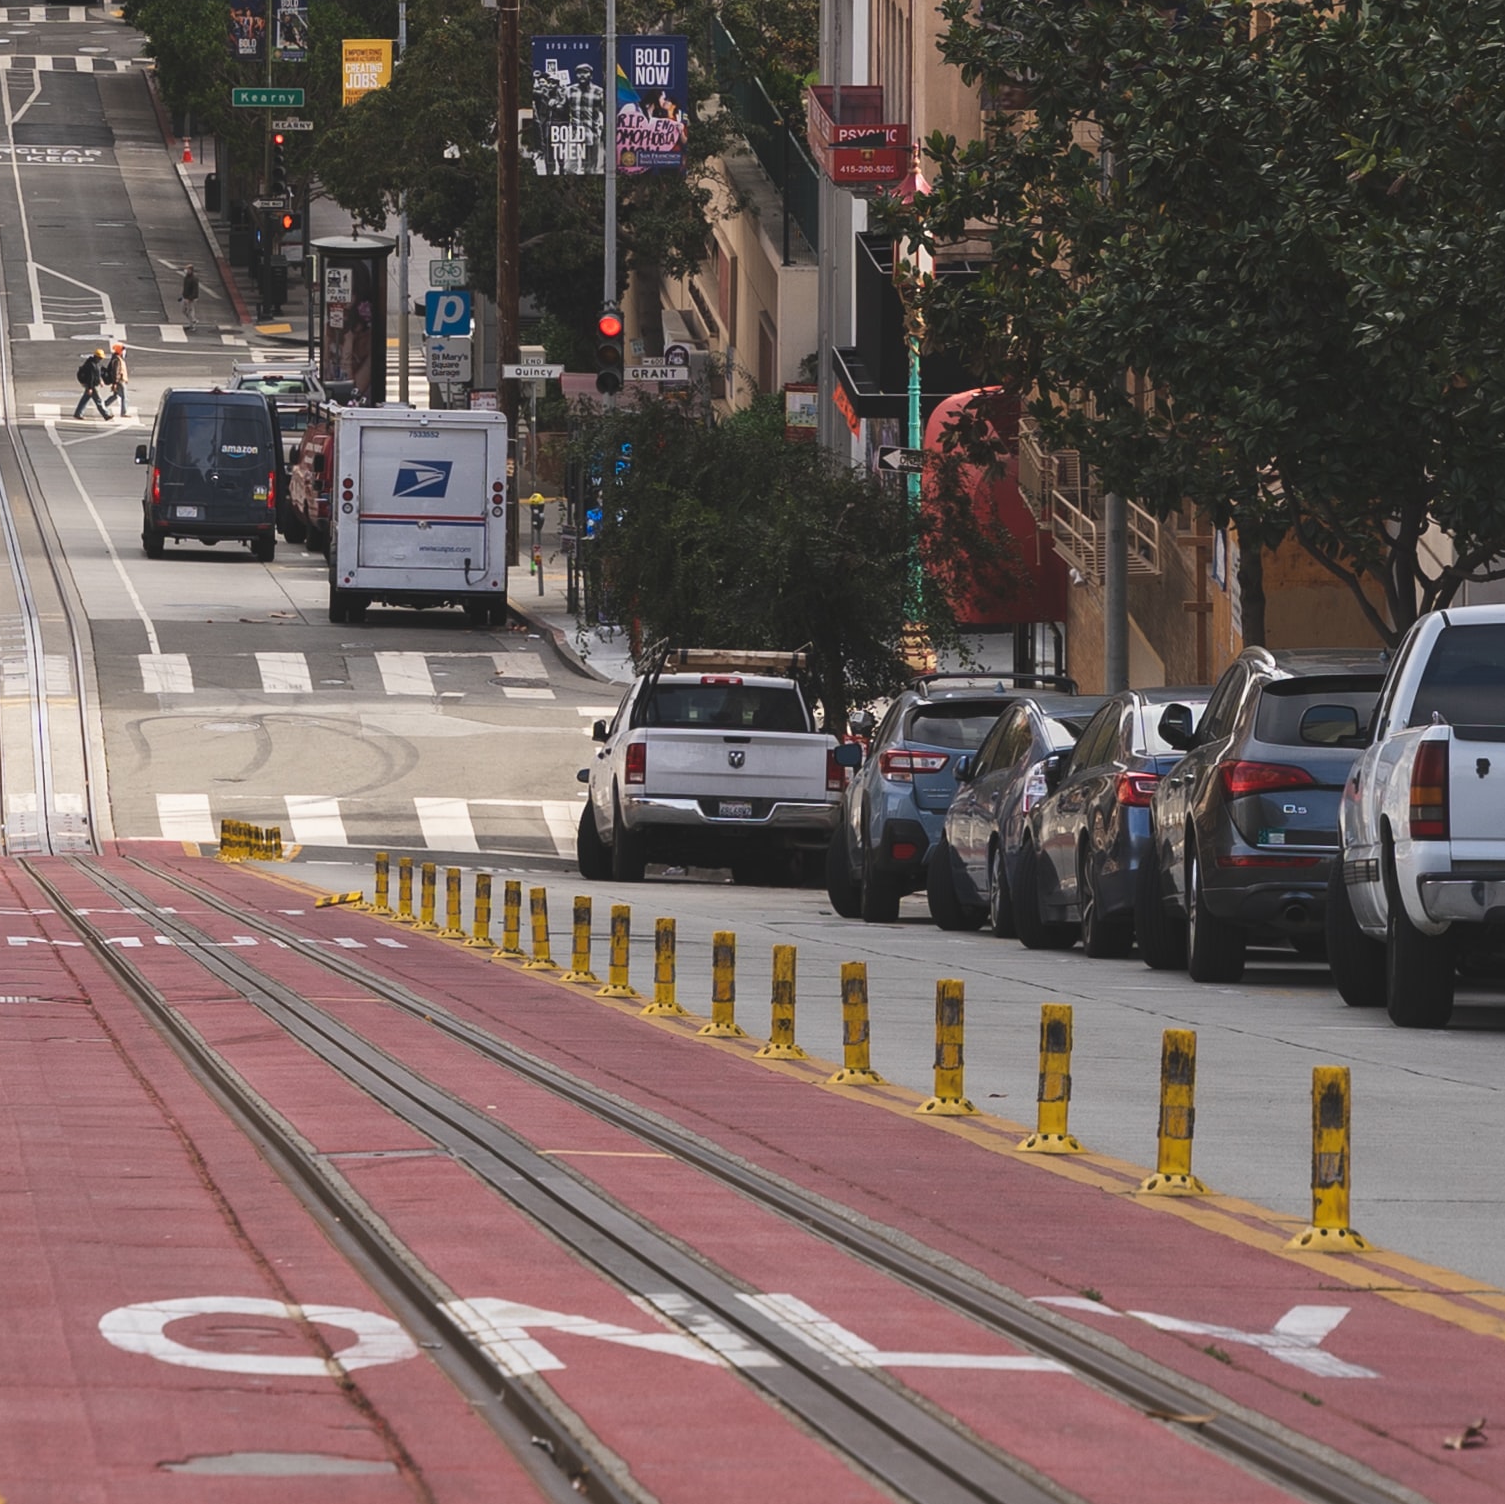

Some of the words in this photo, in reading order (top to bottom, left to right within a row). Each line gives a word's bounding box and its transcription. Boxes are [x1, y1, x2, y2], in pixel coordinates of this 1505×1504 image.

[635, 49, 670, 65] BOLD
[346, 63, 383, 73] CREATING
[346, 73, 381, 89] JOBS.
[635, 67, 669, 85] NOW
[241, 93, 295, 104] Kearny
[654, 120, 674, 134] END
[551, 126, 586, 142] BOLD
[16, 148, 102, 157] CLEAR
[551, 143, 586, 159] THEN
[26, 155, 95, 163] KEEP
[432, 353, 442, 361] St
[444, 353, 468, 363] Mary's
[432, 361, 459, 371] Square
[432, 369, 460, 378] Garage
[515, 368, 553, 377] Quincy
[632, 369, 676, 379] GRANT
[222, 445, 258, 455] amazon
[1283, 804, 1308, 814] Q5
[98, 1294, 1383, 1379] ONLY
